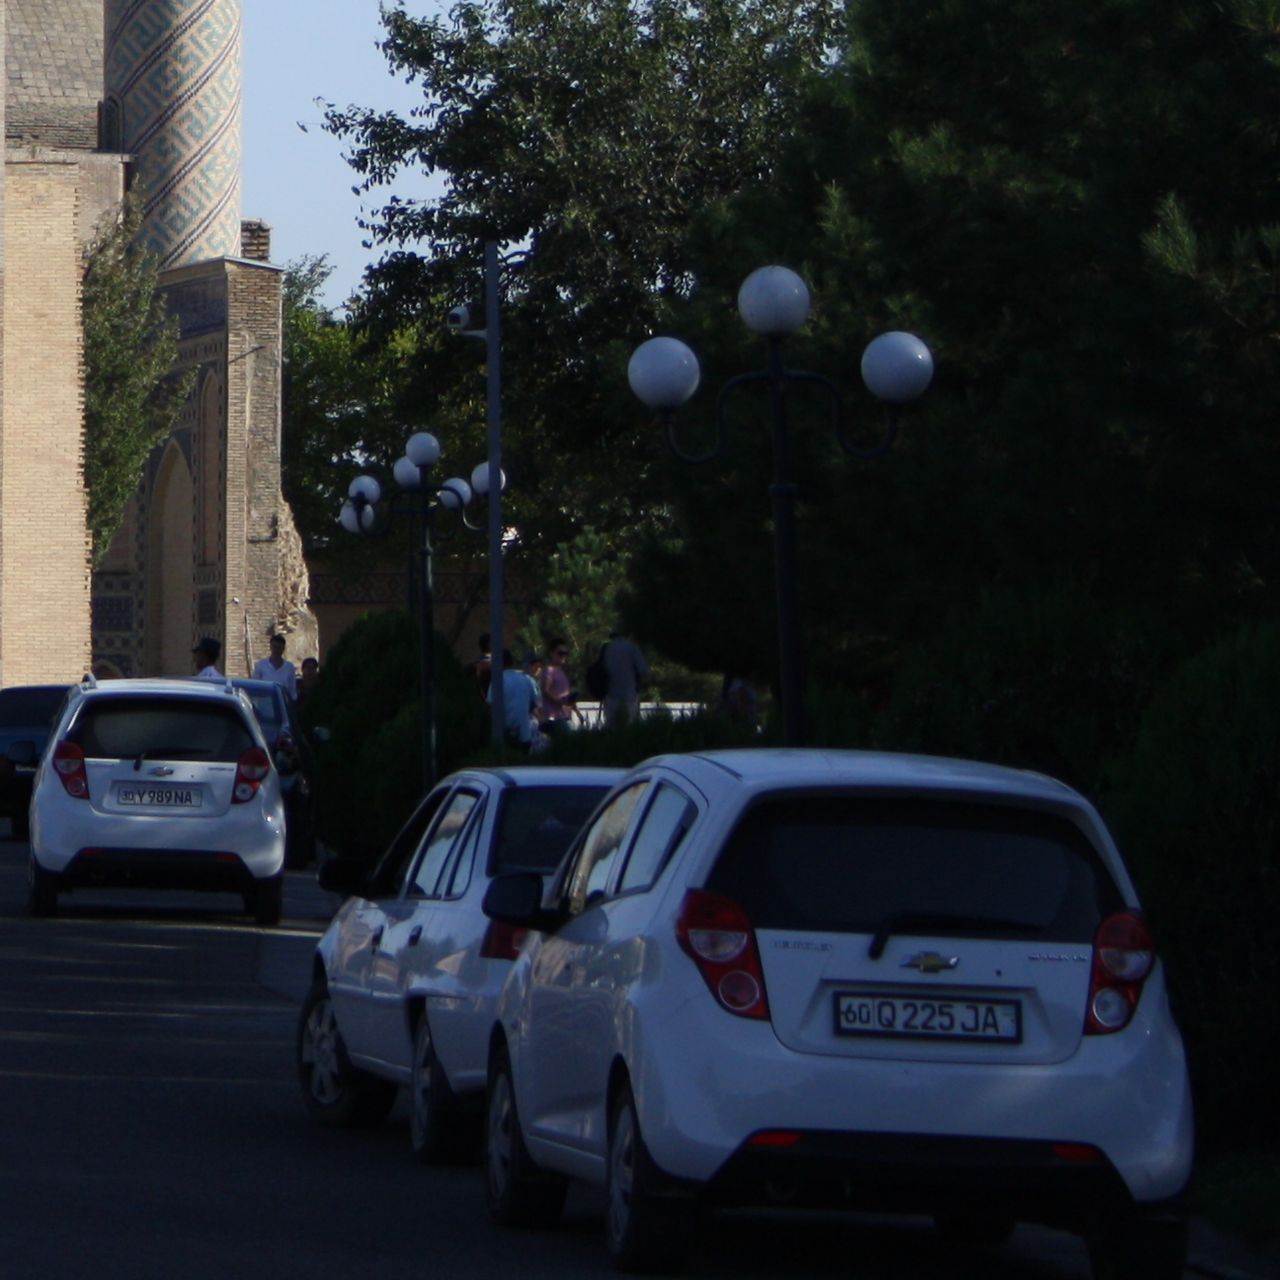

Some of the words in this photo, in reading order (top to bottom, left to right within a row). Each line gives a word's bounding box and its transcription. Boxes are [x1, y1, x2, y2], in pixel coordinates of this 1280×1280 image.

[148, 789, 173, 803] 989
[174, 791, 193, 804] NA
[844, 1001, 871, 1024] 60
[877, 1000, 896, 1029] Q
[902, 1002, 955, 1032] 225
[961, 1004, 1000, 1034] JA
